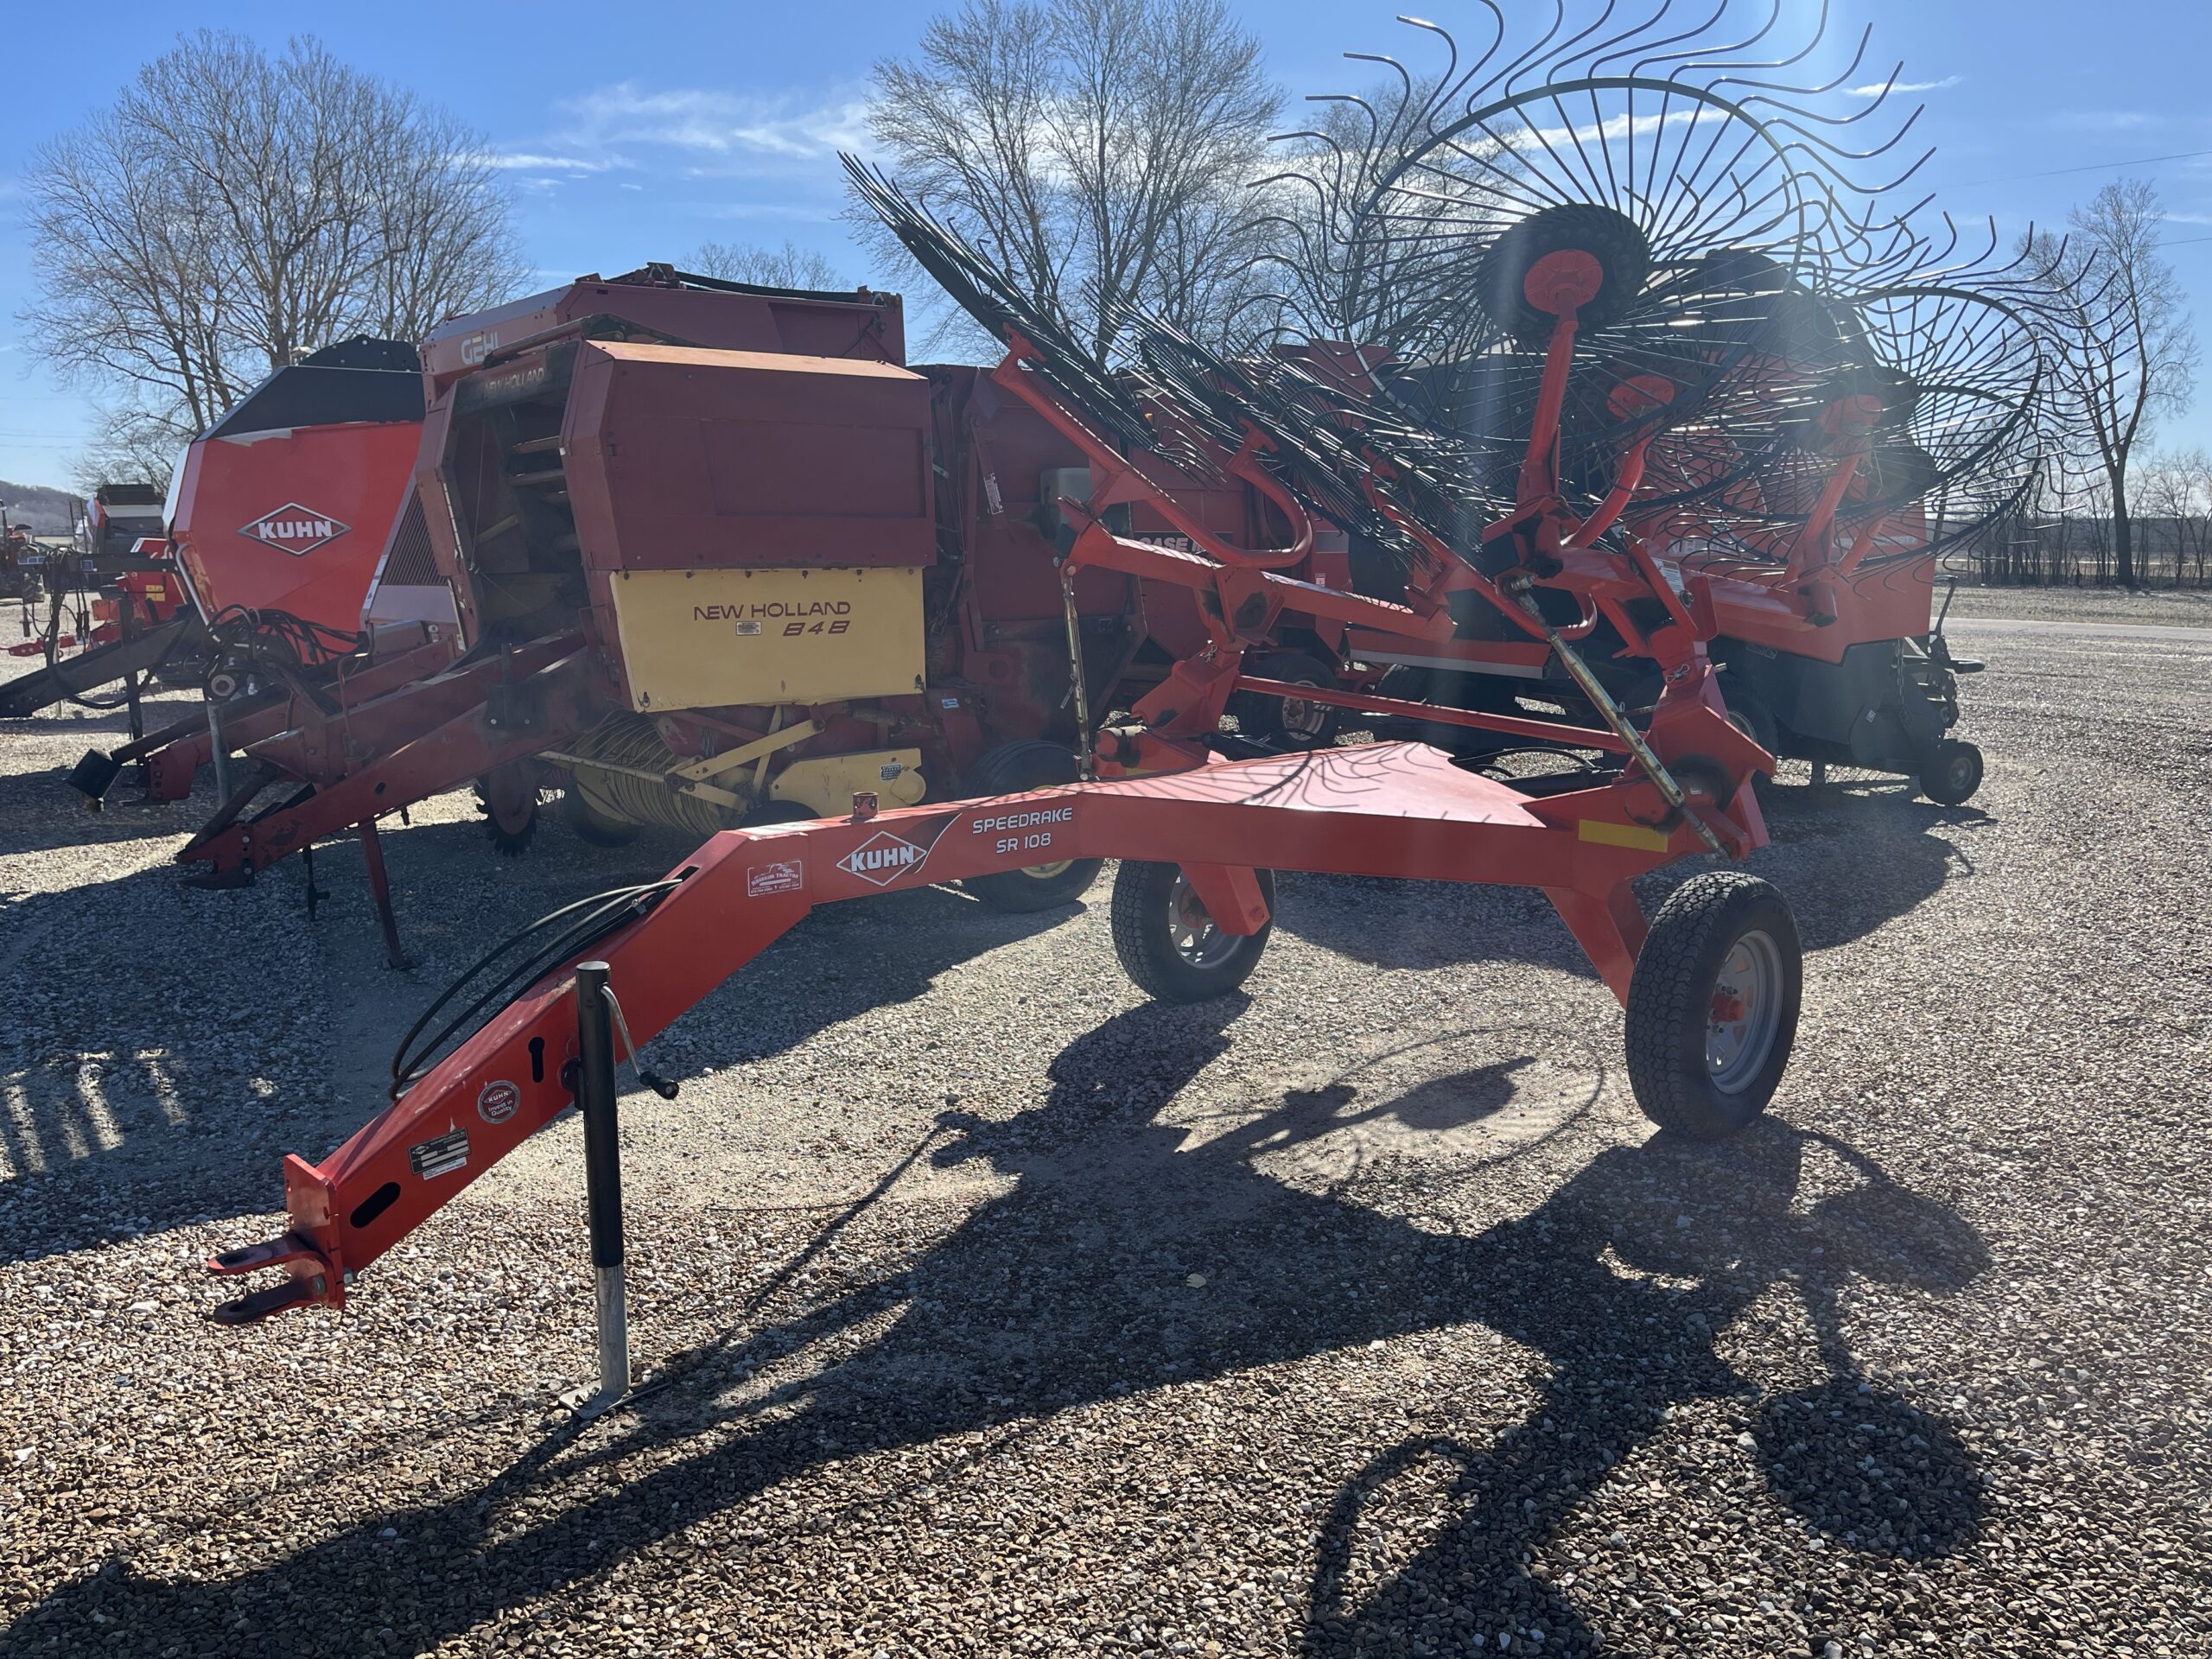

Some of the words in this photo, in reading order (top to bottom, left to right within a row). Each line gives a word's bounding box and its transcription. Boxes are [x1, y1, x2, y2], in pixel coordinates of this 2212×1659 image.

[257, 520, 333, 539] KUHN
[694, 604, 745, 621] NEW
[751, 601, 851, 618] HOLLAND
[782, 620, 851, 637] 848
[972, 807, 1073, 836] SPEEDRAKE
[995, 837, 1018, 855] SR
[1024, 832, 1052, 849] 108
[850, 844, 915, 874] KUHN
[488, 1090, 509, 1103] KUHN
[487, 1102, 506, 1113] Invest
[491, 1106, 512, 1116] Quality
